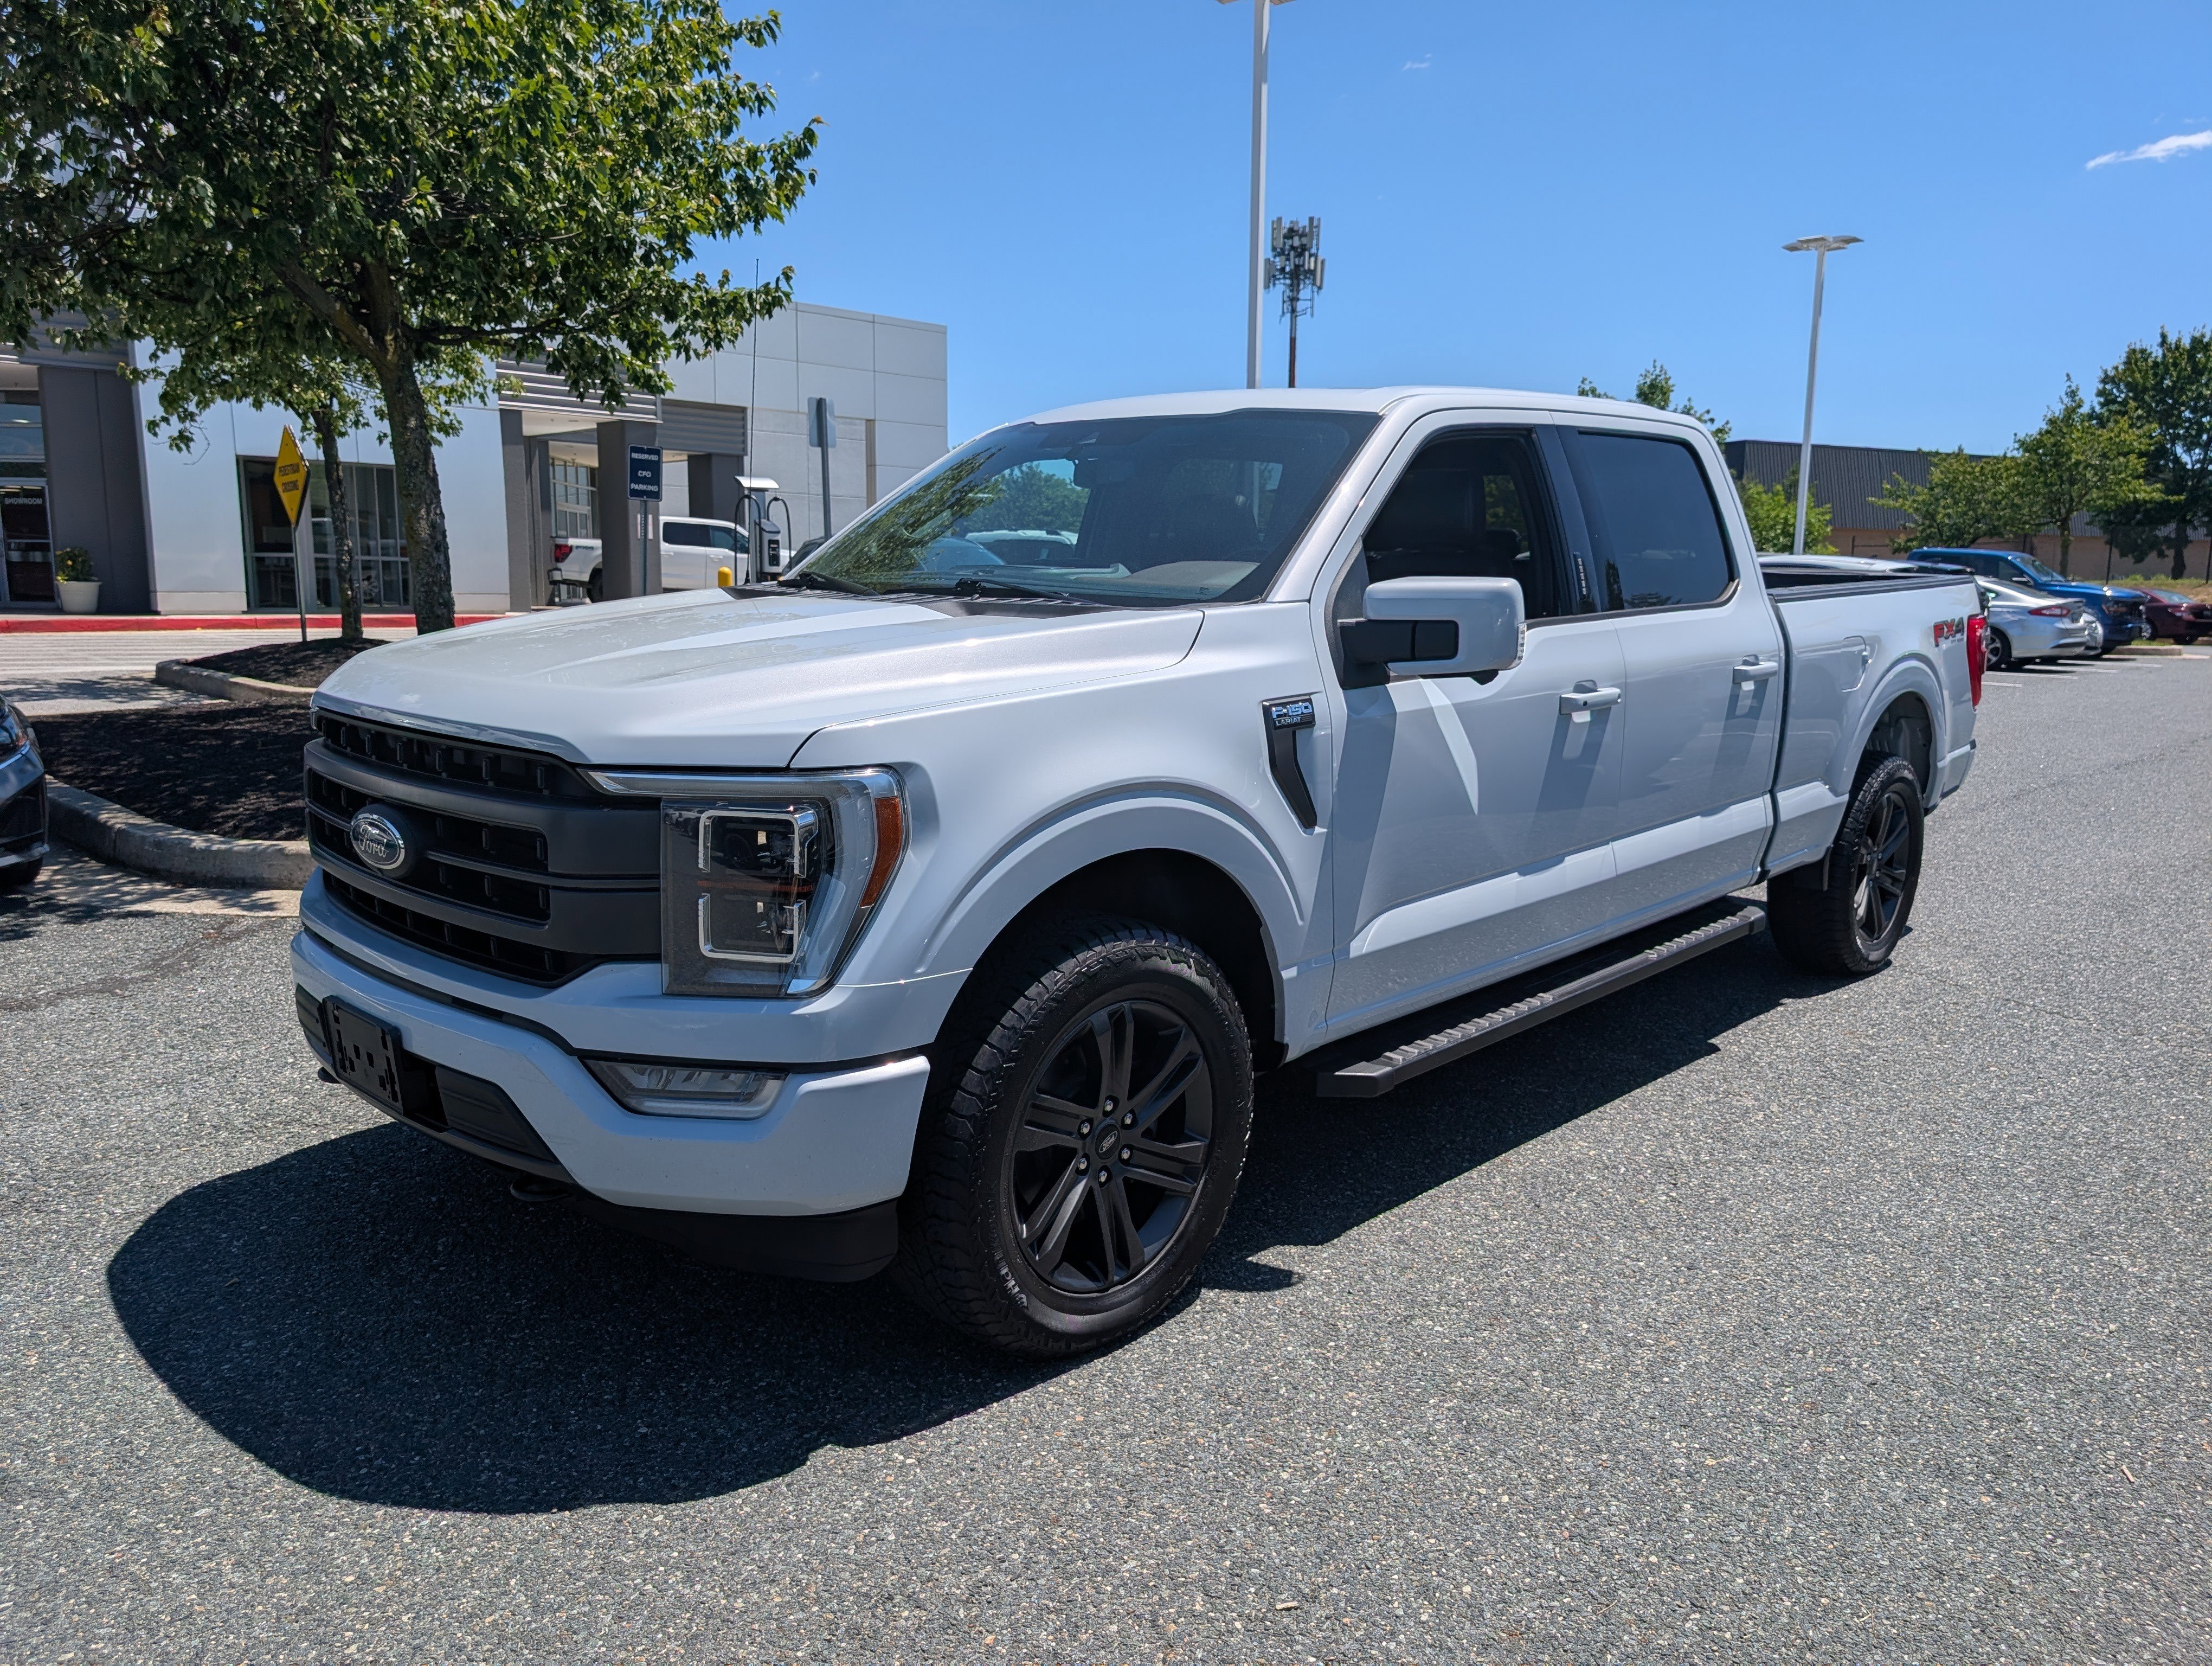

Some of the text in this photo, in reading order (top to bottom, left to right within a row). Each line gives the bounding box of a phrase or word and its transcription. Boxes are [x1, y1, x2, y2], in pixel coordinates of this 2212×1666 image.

[631, 452, 659, 461] RESERVED
[631, 483, 659, 492] PARKING
[1933, 617, 1965, 648] FX4
[1271, 702, 1313, 719] F-150
[1276, 716, 1302, 727] LARIAT
[358, 824, 389, 857] Ford
